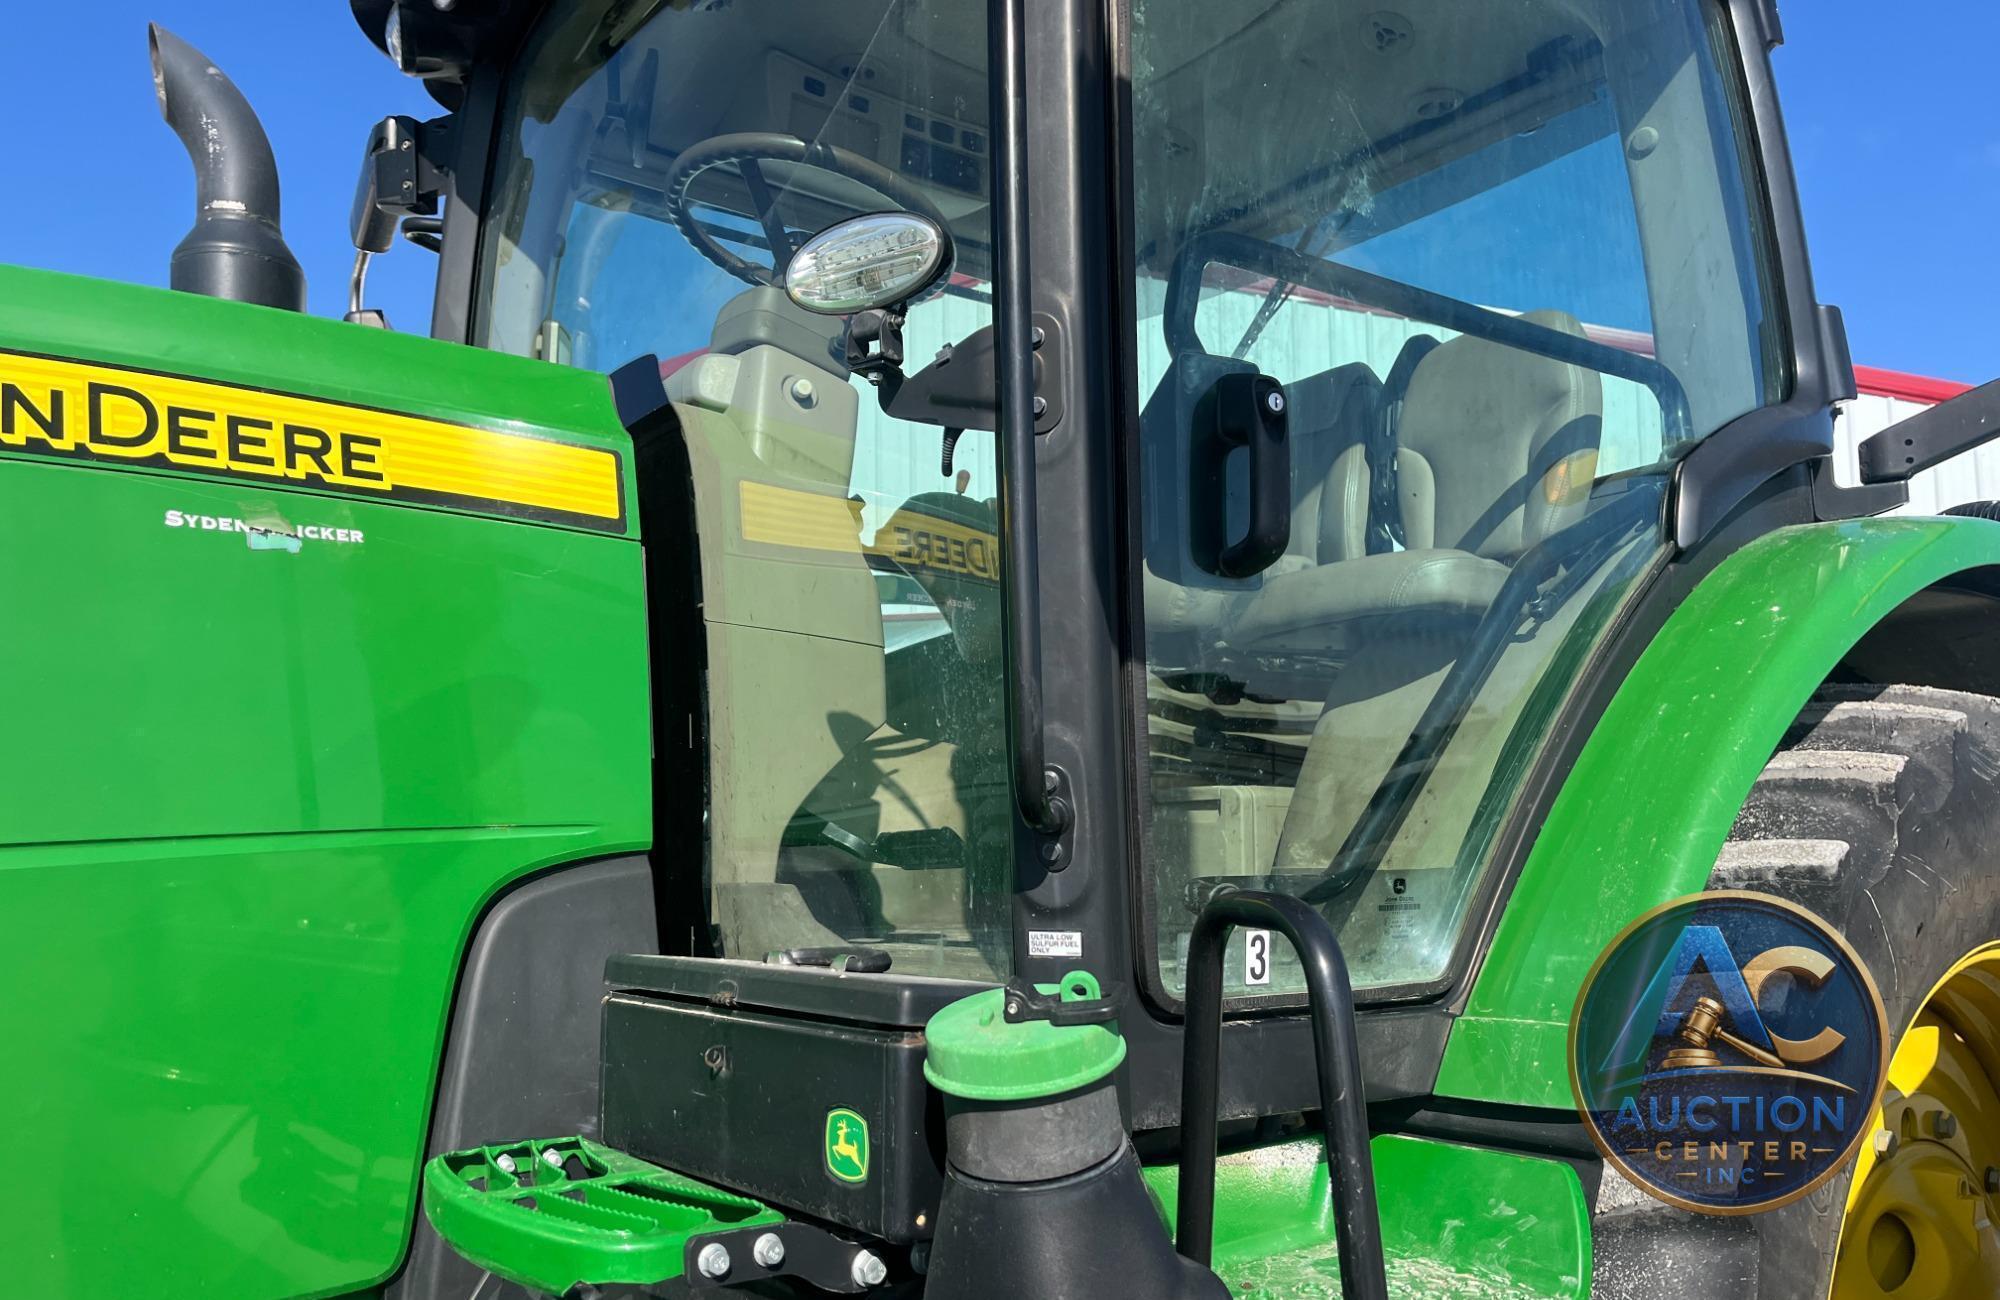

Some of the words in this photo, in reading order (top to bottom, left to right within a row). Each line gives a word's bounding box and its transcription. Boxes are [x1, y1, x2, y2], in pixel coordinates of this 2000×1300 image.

[87, 381, 384, 482] DEERE
[164, 510, 364, 543] SYDENICKER
[1250, 934, 1266, 980] 3
